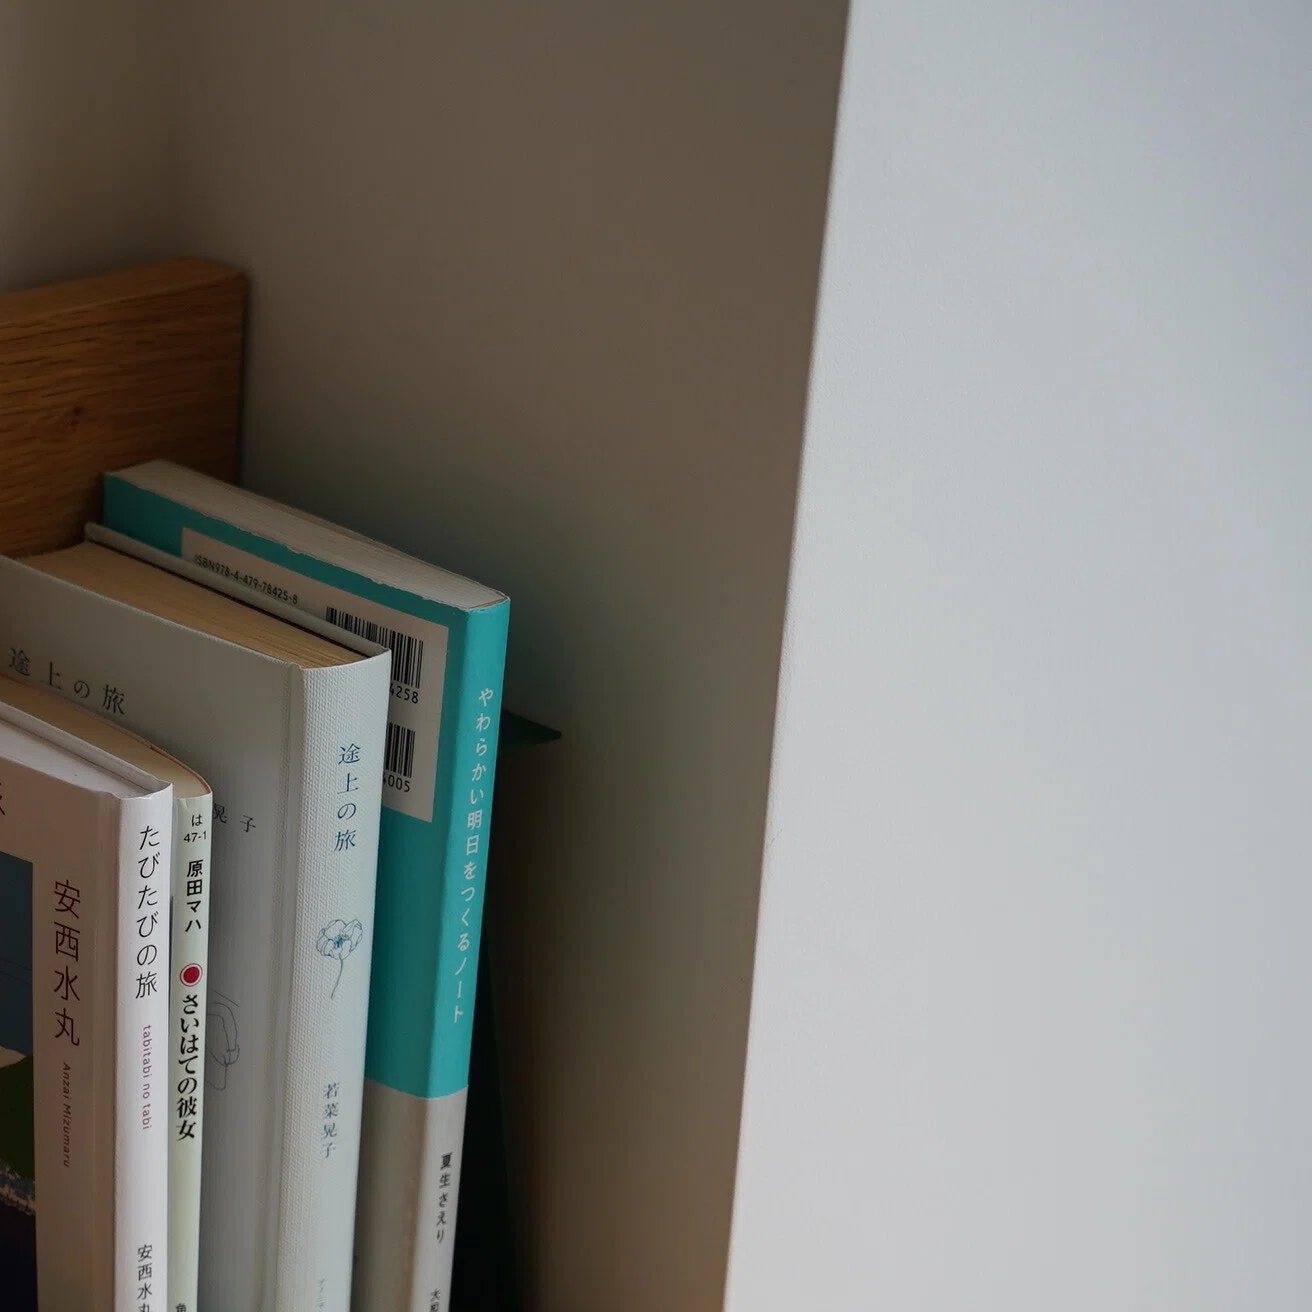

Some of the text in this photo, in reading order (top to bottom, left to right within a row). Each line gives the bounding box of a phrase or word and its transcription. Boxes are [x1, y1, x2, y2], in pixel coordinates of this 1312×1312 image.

[9, 646, 125, 715] 途上の旅
[183, 830, 207, 843] 47-1
[191, 814, 203, 827] は
[333, 743, 361, 852] 途上の旅
[184, 859, 204, 932] 原田マハ
[452, 687, 494, 1024] やわらかい明日をつくるノート
[53, 879, 80, 1046] 安西水丸
[135, 825, 161, 999] たびたびの旅
[62, 1062, 72, 1168] Anzai Mizumaru
[142, 1025, 153, 1130] tabitabi no tabi
[176, 994, 200, 1142] さいはての彼女
[321, 1082, 341, 1159] 若菜晃子
[436, 1152, 453, 1244] 夏生さえり
